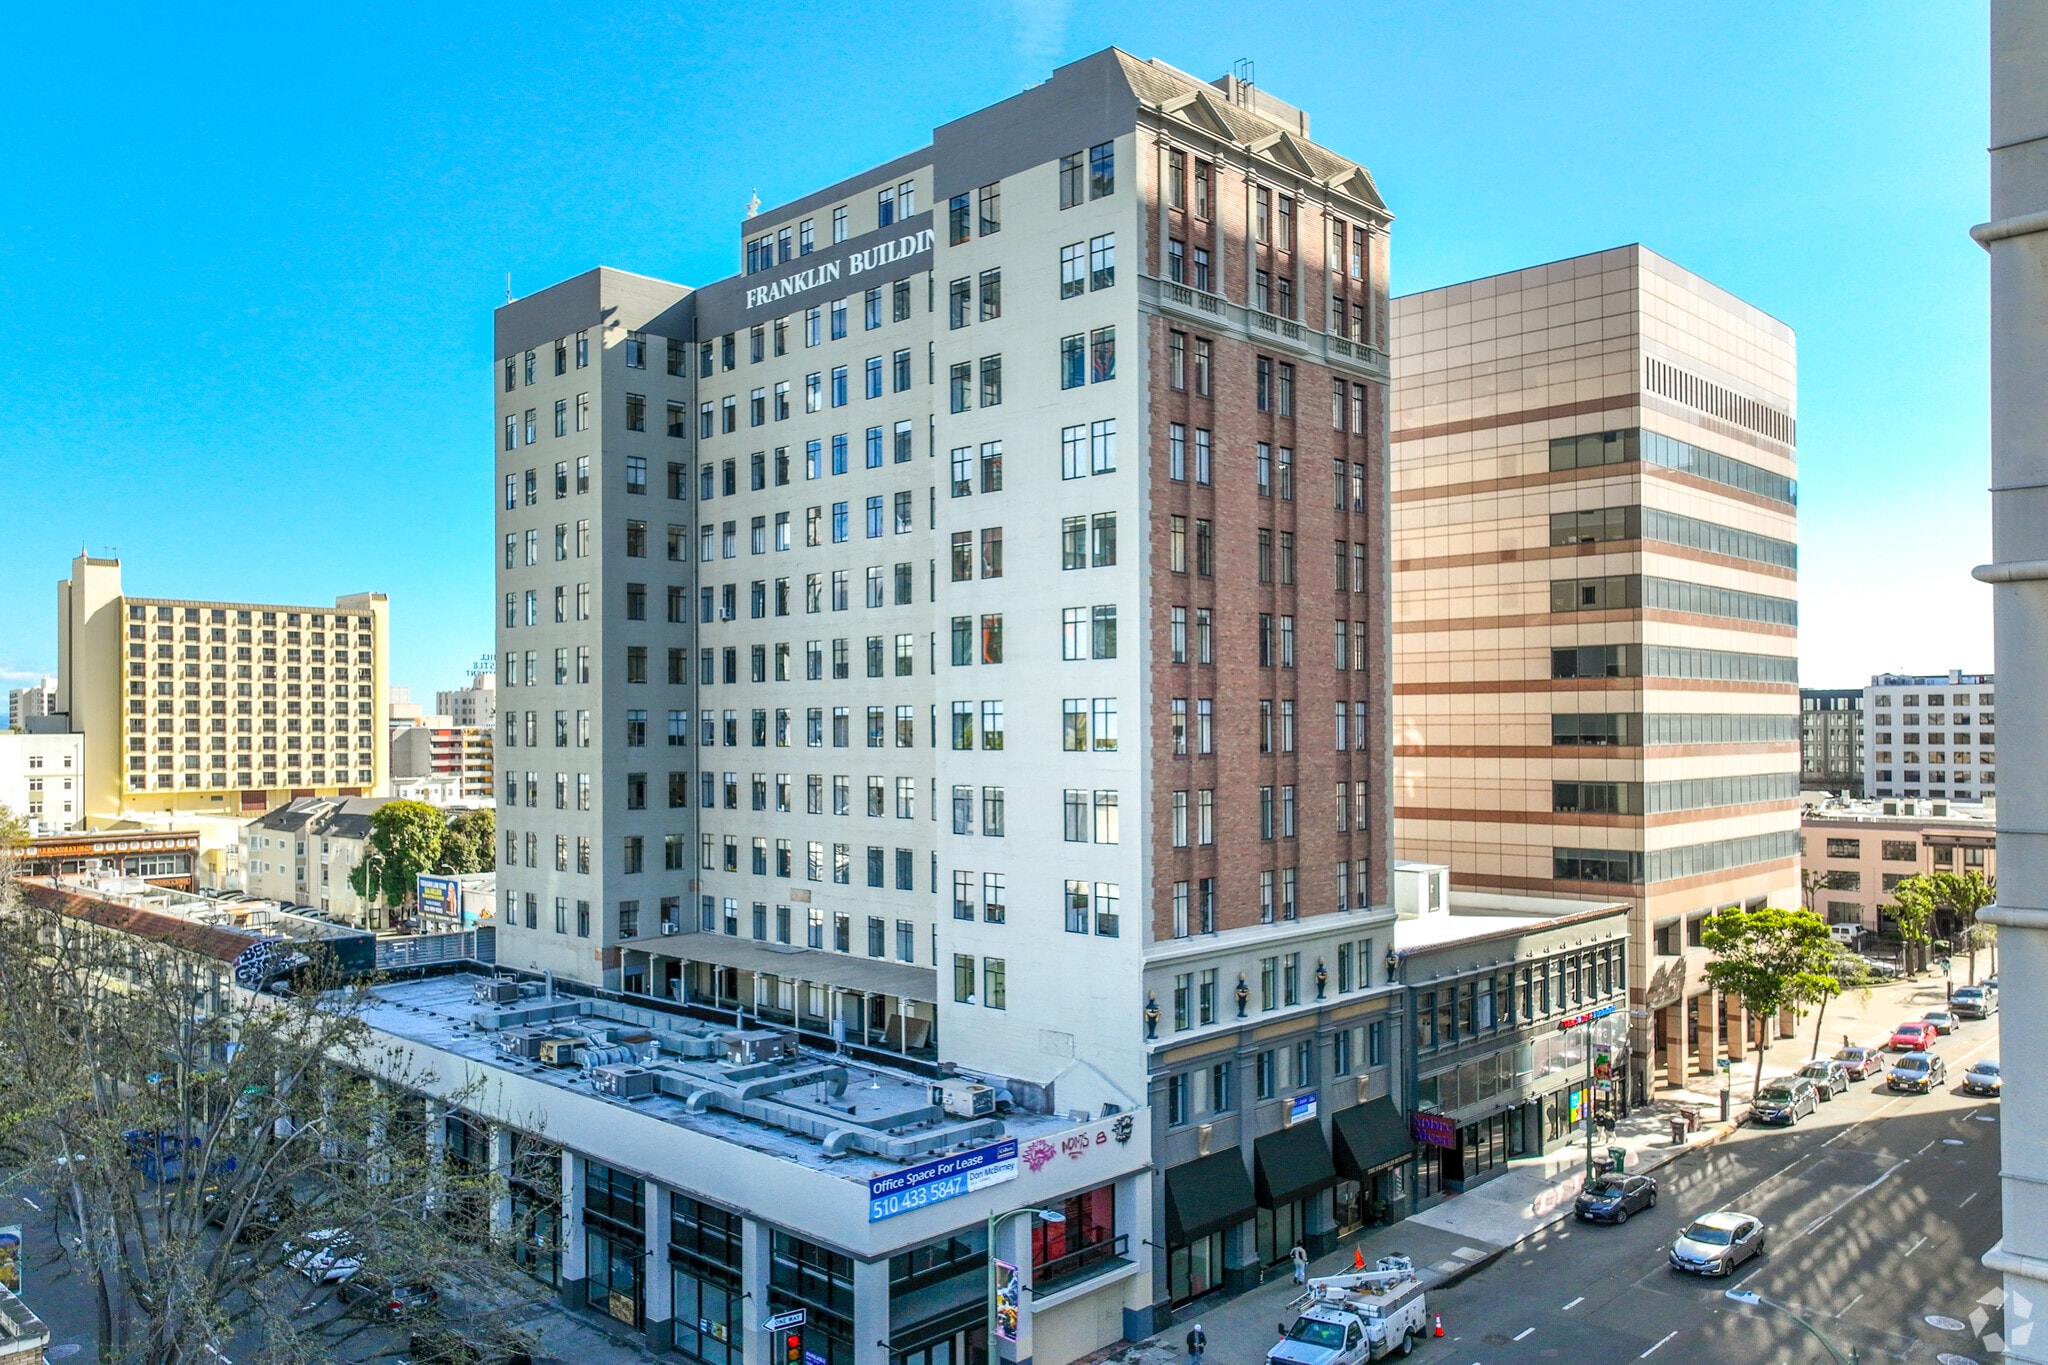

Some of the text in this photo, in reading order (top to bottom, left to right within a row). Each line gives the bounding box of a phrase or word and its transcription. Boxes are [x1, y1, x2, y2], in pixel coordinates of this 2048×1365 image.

[745, 260, 840, 310] FRANKLIN
[873, 1155, 983, 1195] Office Space For Lease
[969, 1171, 983, 1181] Don
[873, 1177, 962, 1219] 510 433 5847
[774, 1314, 801, 1326] ONE WAY
